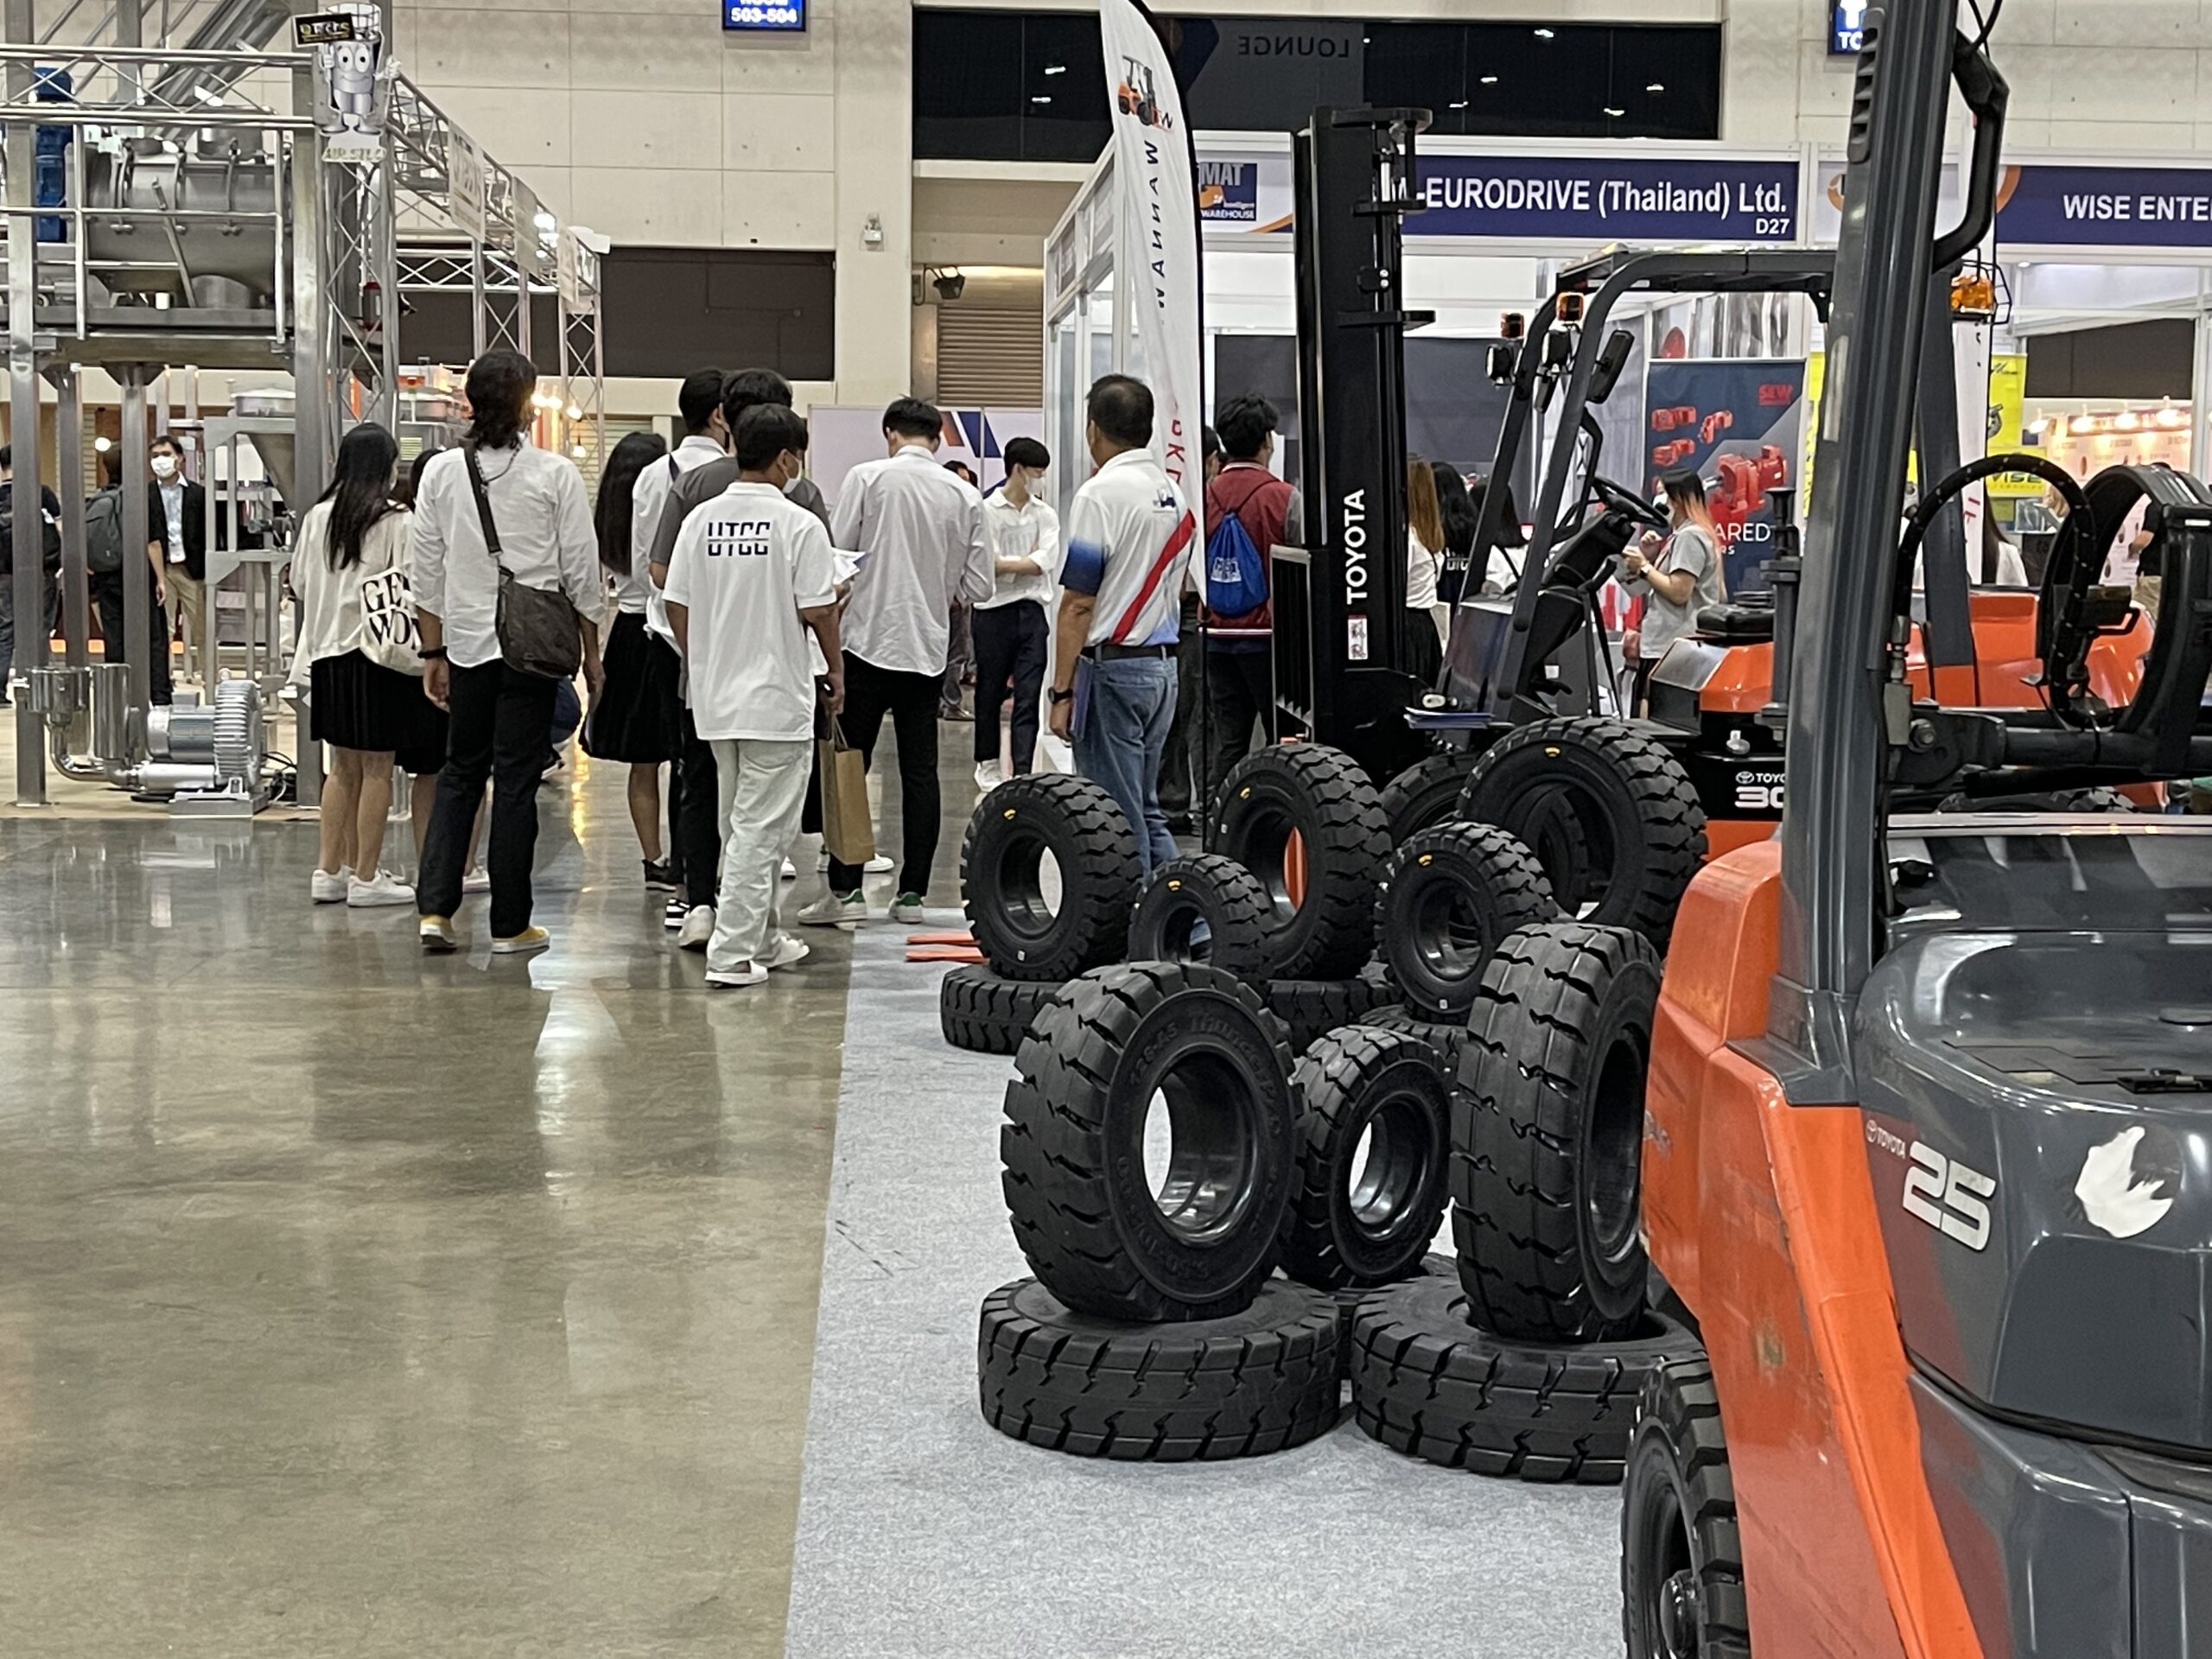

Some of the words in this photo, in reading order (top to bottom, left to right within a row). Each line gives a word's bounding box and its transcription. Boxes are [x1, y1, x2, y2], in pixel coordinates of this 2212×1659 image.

[731, 7, 798, 23] 503-504
[1838, 31, 1864, 50] TO
[1599, 180, 1730, 220] (Thailand)
[1738, 182, 1787, 213] Ltd.
[2063, 194, 2132, 219] WISE
[2139, 195, 2212, 221] ENTE
[1755, 218, 1790, 234] D27
[708, 522, 771, 556] UTCC
[1344, 489, 1368, 606] TOYOTA
[1756, 772, 1786, 783] TOYO
[1877, 1127, 1906, 1160] TOYOTA
[1903, 1140, 1997, 1251] 25
